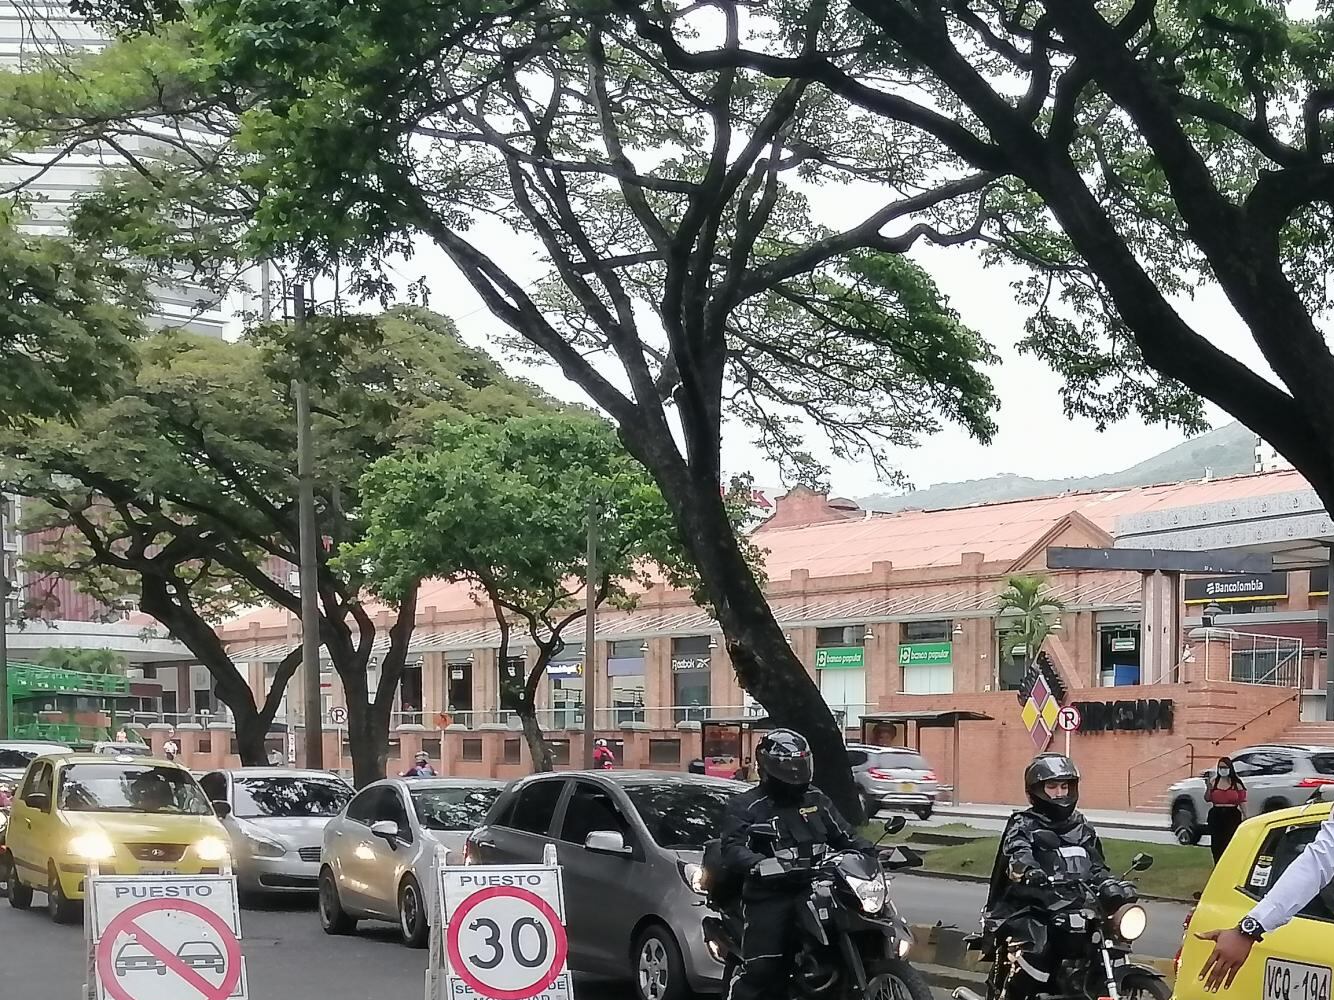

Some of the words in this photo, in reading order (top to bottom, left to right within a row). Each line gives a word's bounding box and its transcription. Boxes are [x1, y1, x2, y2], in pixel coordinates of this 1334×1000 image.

[1214, 579, 1264, 593] Bancolombia
[672, 658, 695, 670] Reebok
[460, 875, 541, 887] PUESTO
[115, 885, 213, 898] PUESTO
[469, 917, 548, 969] 30
[548, 981, 566, 991] DE
